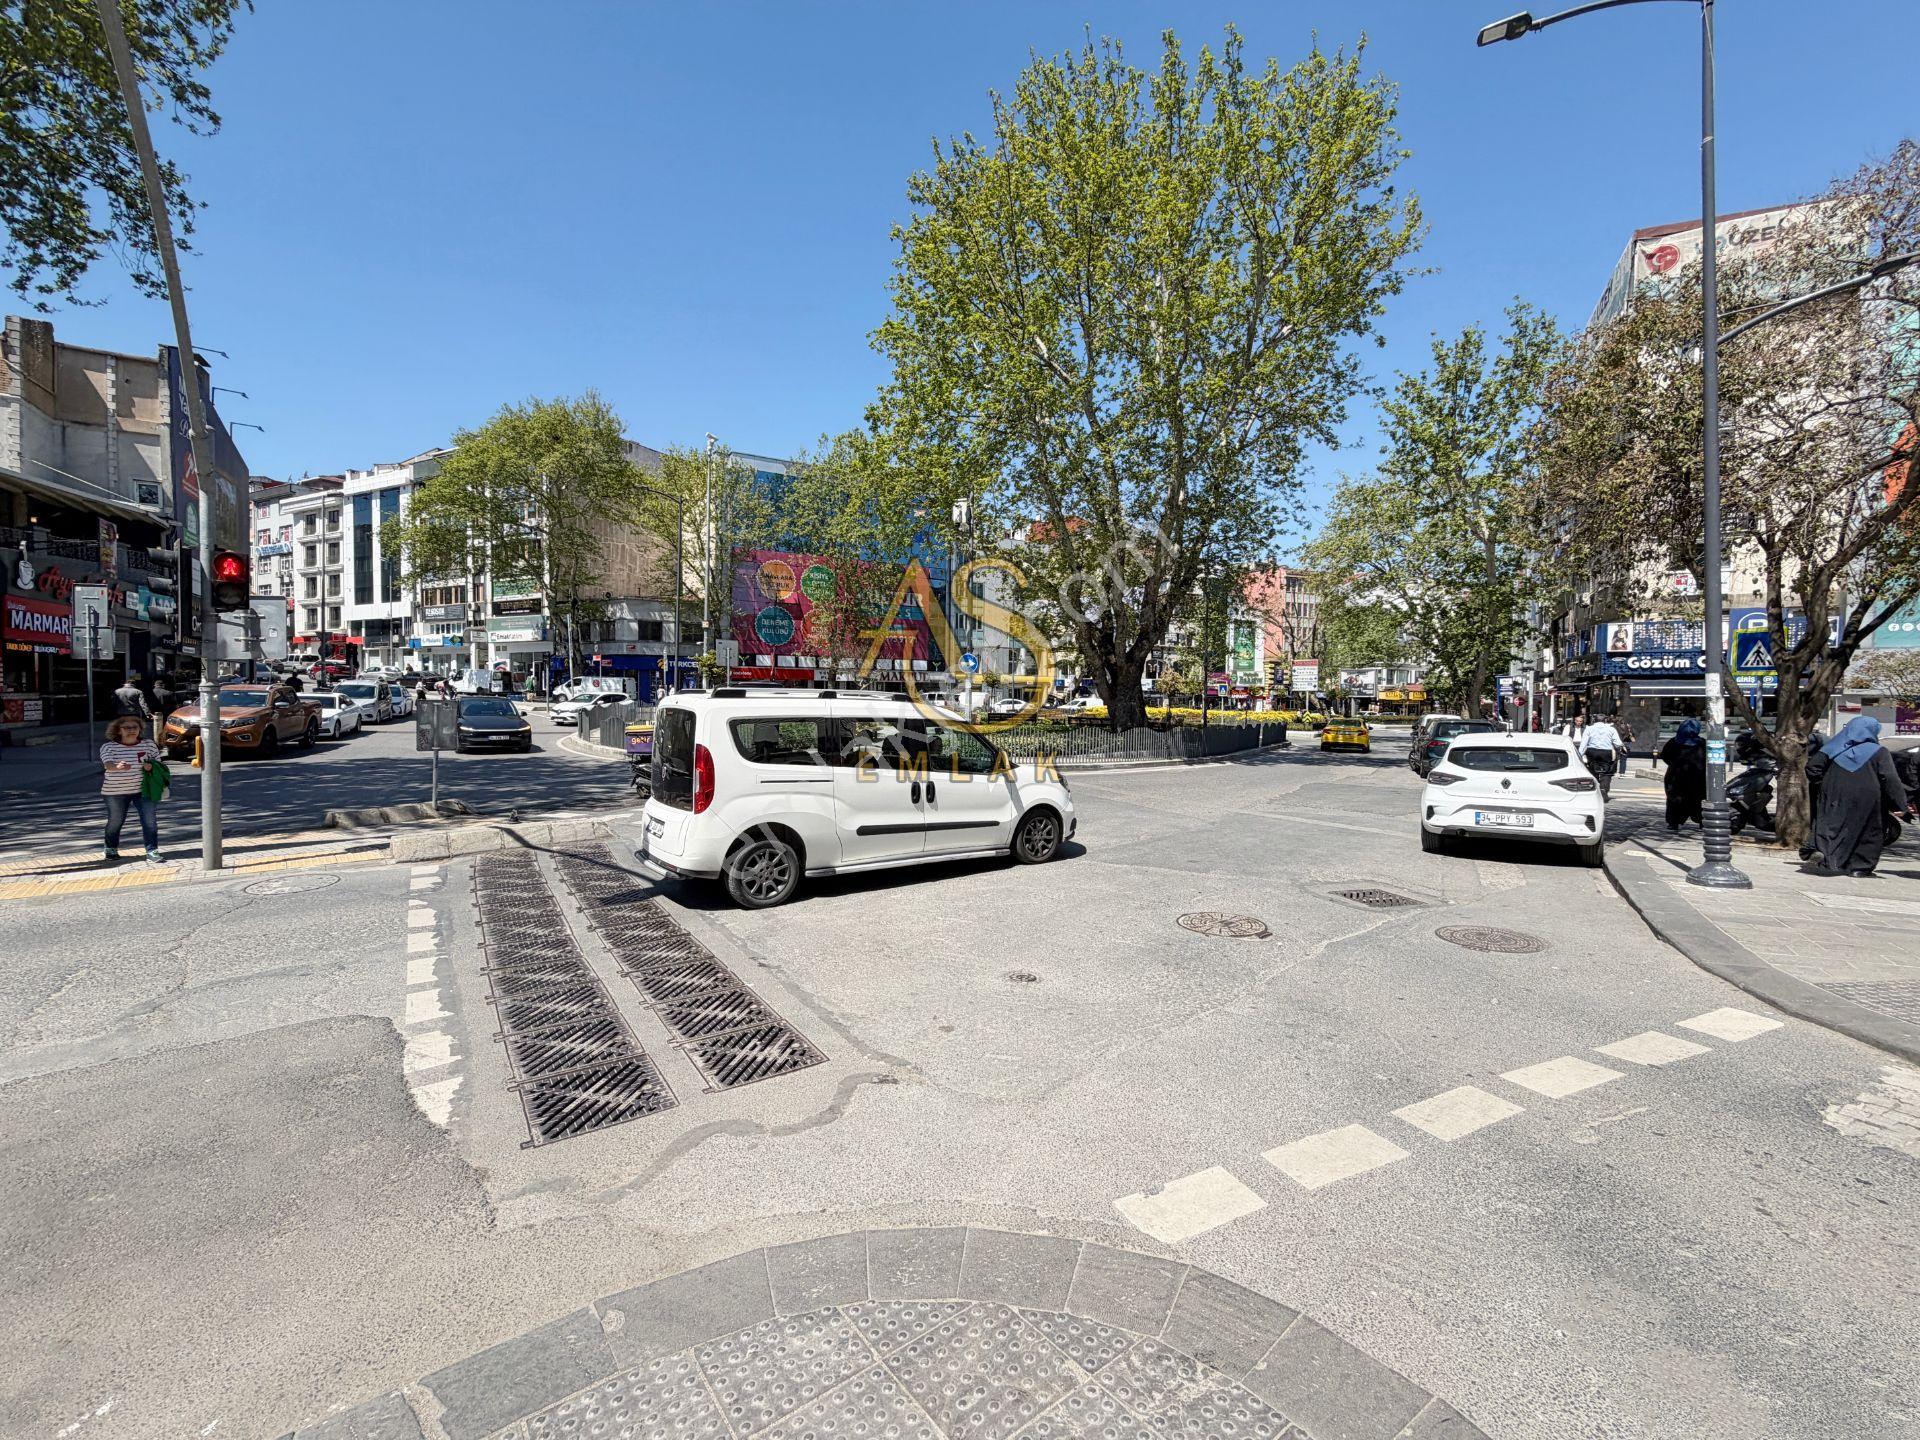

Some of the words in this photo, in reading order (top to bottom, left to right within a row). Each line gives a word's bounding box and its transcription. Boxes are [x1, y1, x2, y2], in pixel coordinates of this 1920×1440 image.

[11, 609, 72, 635] MARMARİ
[761, 618, 789, 626] DENEME
[1627, 655, 1690, 669] Gözüm
[1736, 675, 1756, 683] GİRİŞ
[1480, 812, 1491, 822] 34
[1495, 813, 1511, 823] PPY
[1515, 814, 1532, 824] 593
